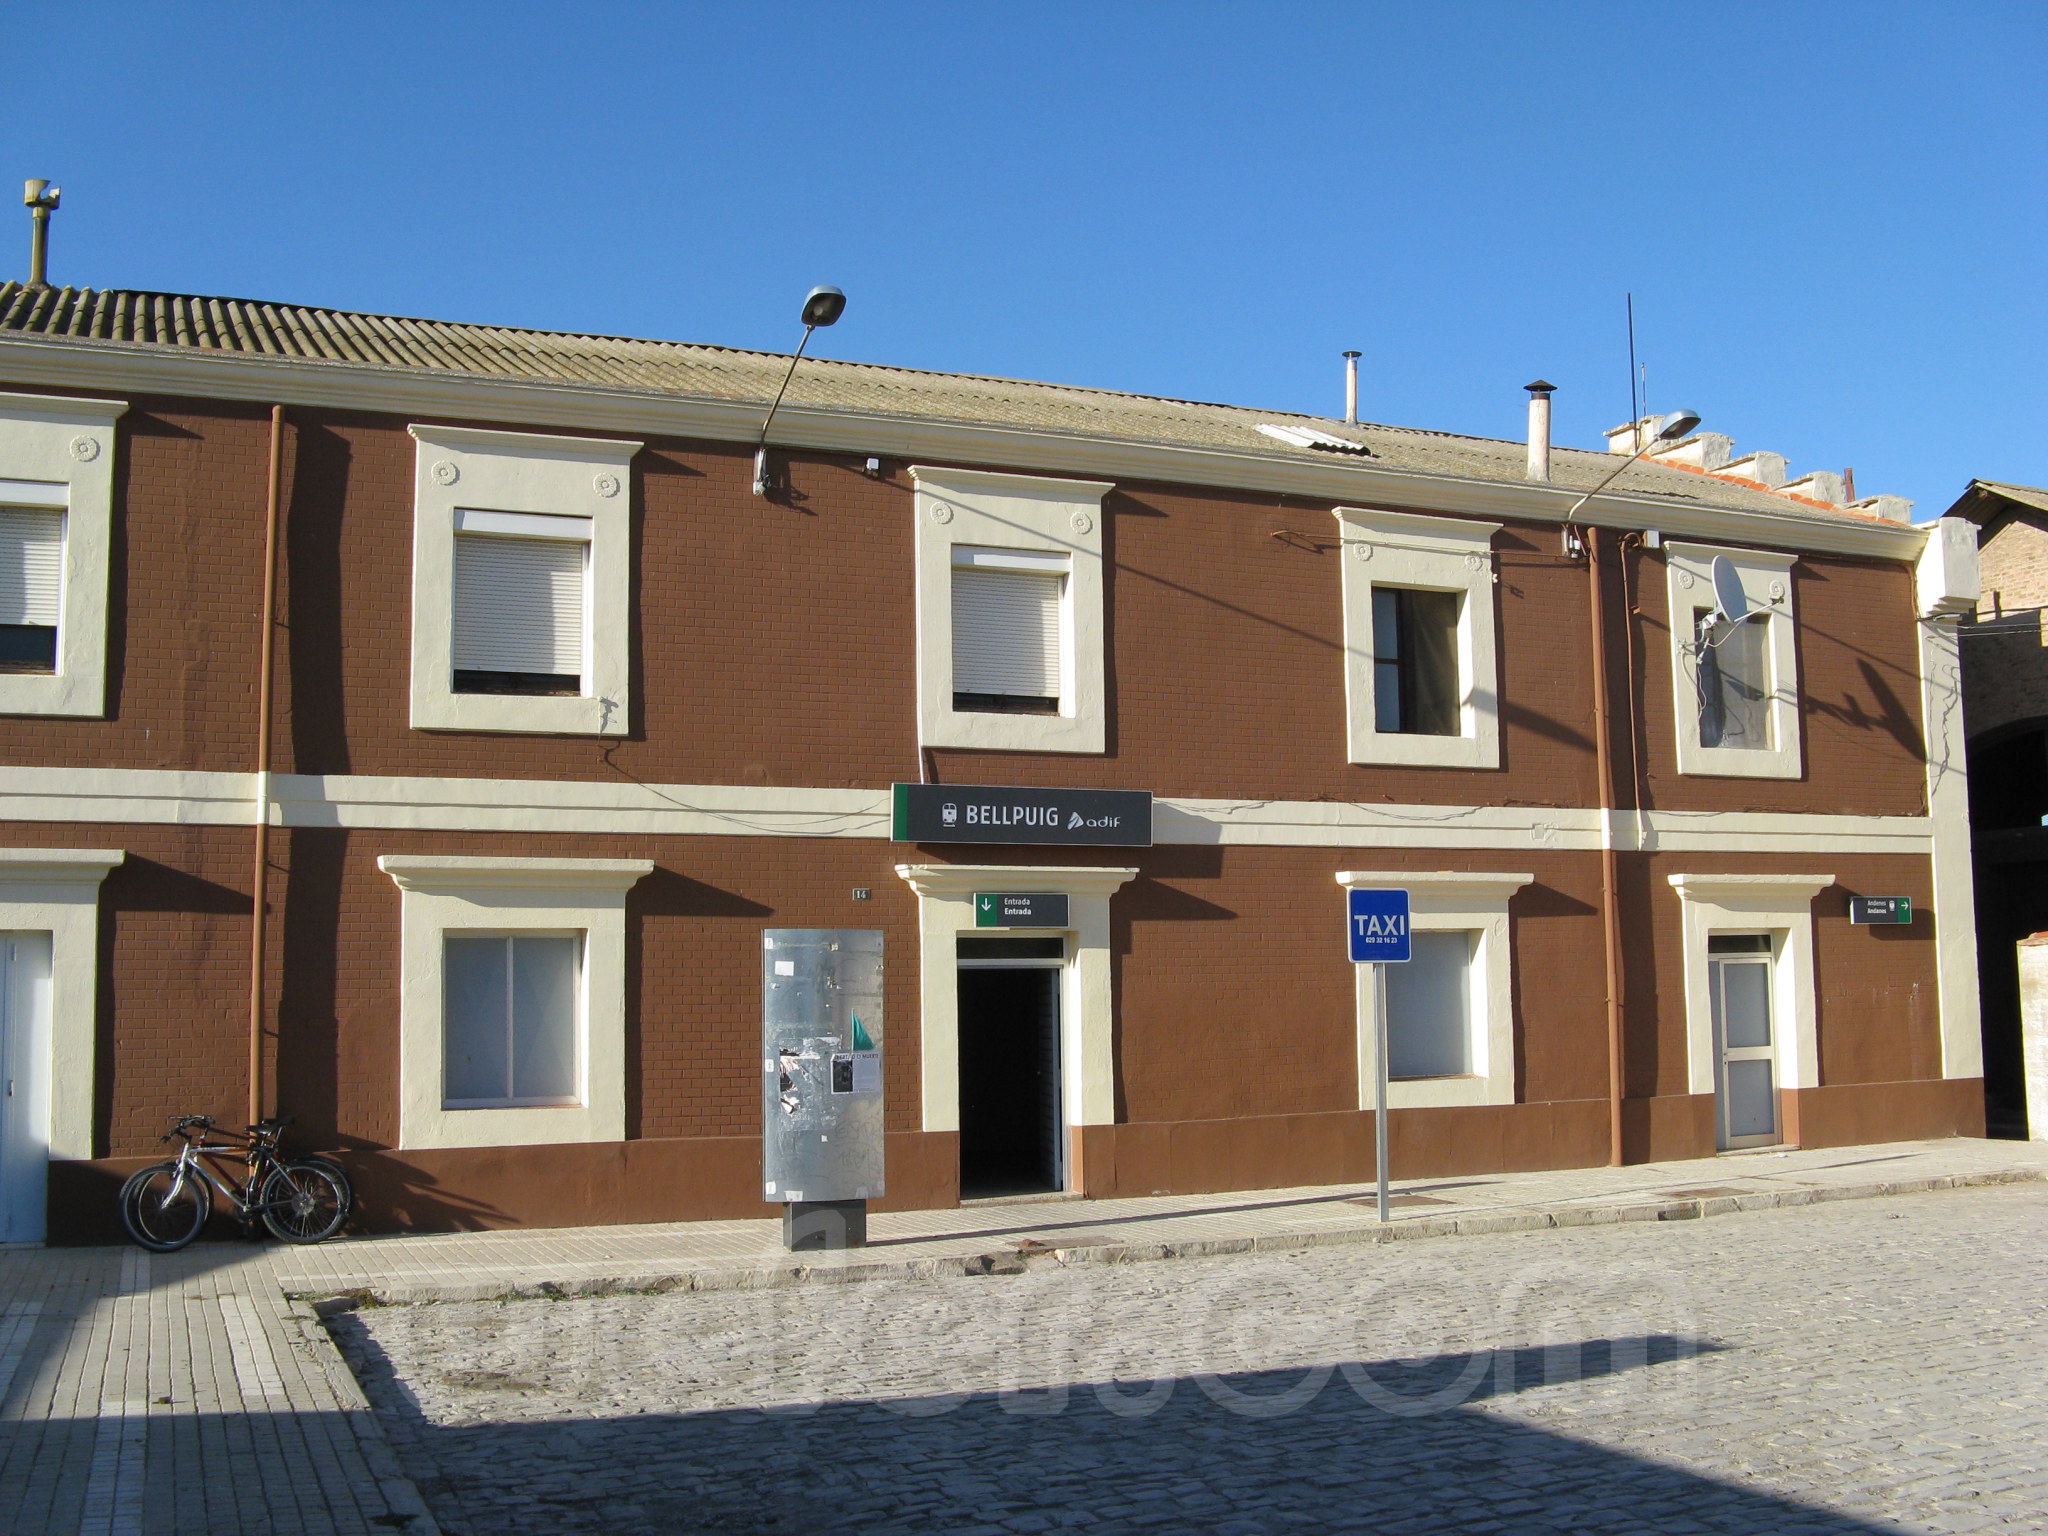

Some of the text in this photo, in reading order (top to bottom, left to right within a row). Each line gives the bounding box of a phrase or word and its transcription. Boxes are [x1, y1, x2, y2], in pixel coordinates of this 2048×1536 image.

[966, 804, 1059, 826] BELLPUIG
[1086, 813, 1121, 828] adif
[1004, 898, 1031, 906] Entrada
[1004, 907, 1032, 915] Entrada
[1354, 914, 1405, 936] TAXI
